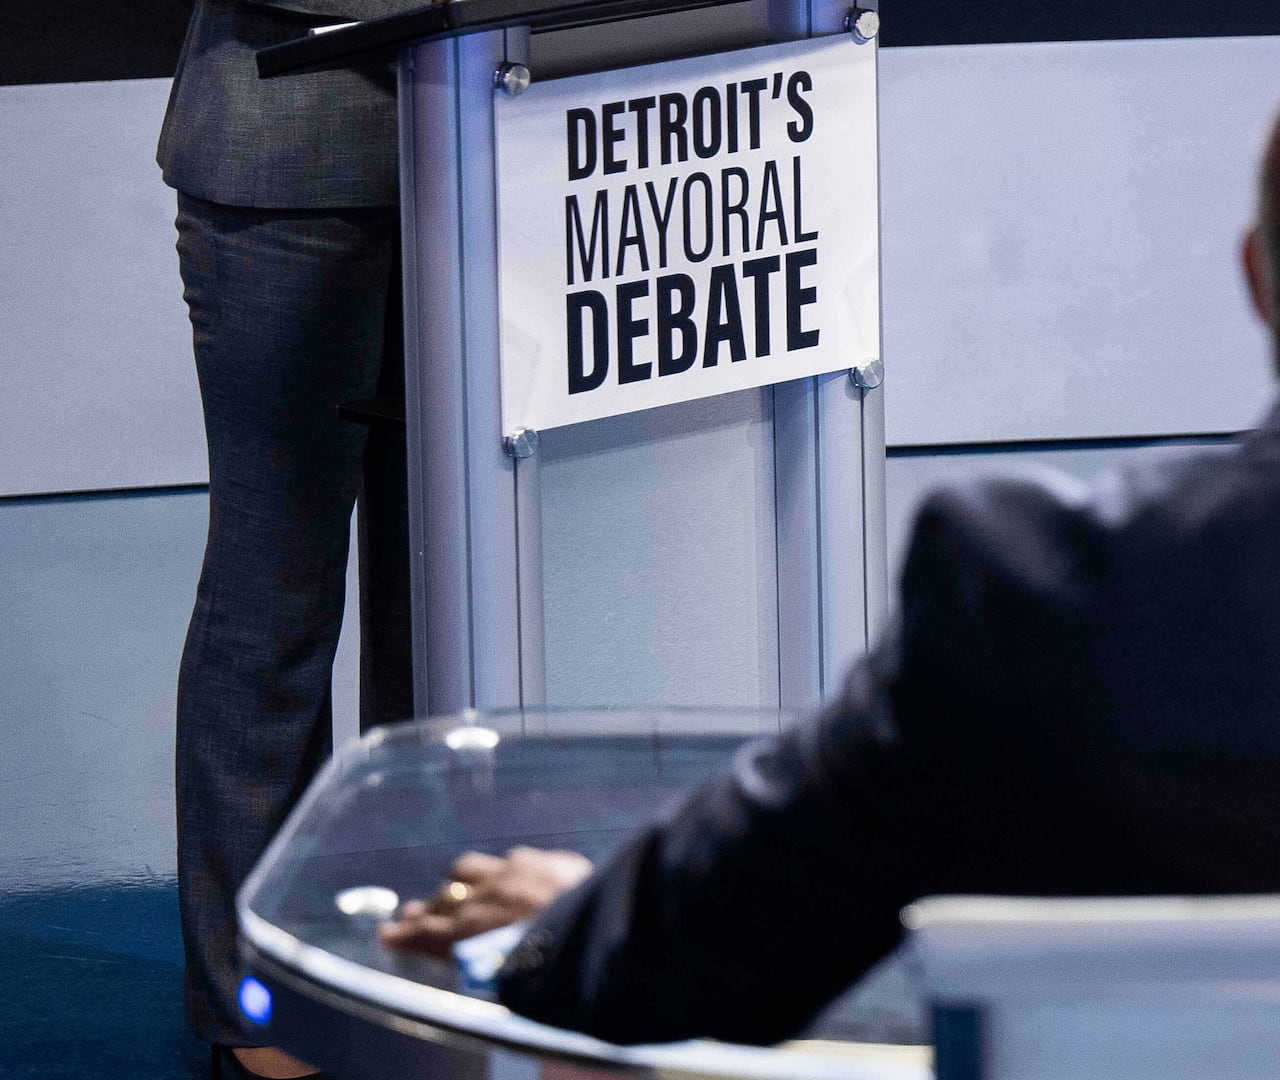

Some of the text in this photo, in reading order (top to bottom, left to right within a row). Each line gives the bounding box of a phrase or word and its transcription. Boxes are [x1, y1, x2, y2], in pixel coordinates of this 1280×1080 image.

[566, 70, 815, 182] DETROIT'S
[565, 155, 819, 286] MAYORAL
[566, 247, 820, 396] DEBATE
